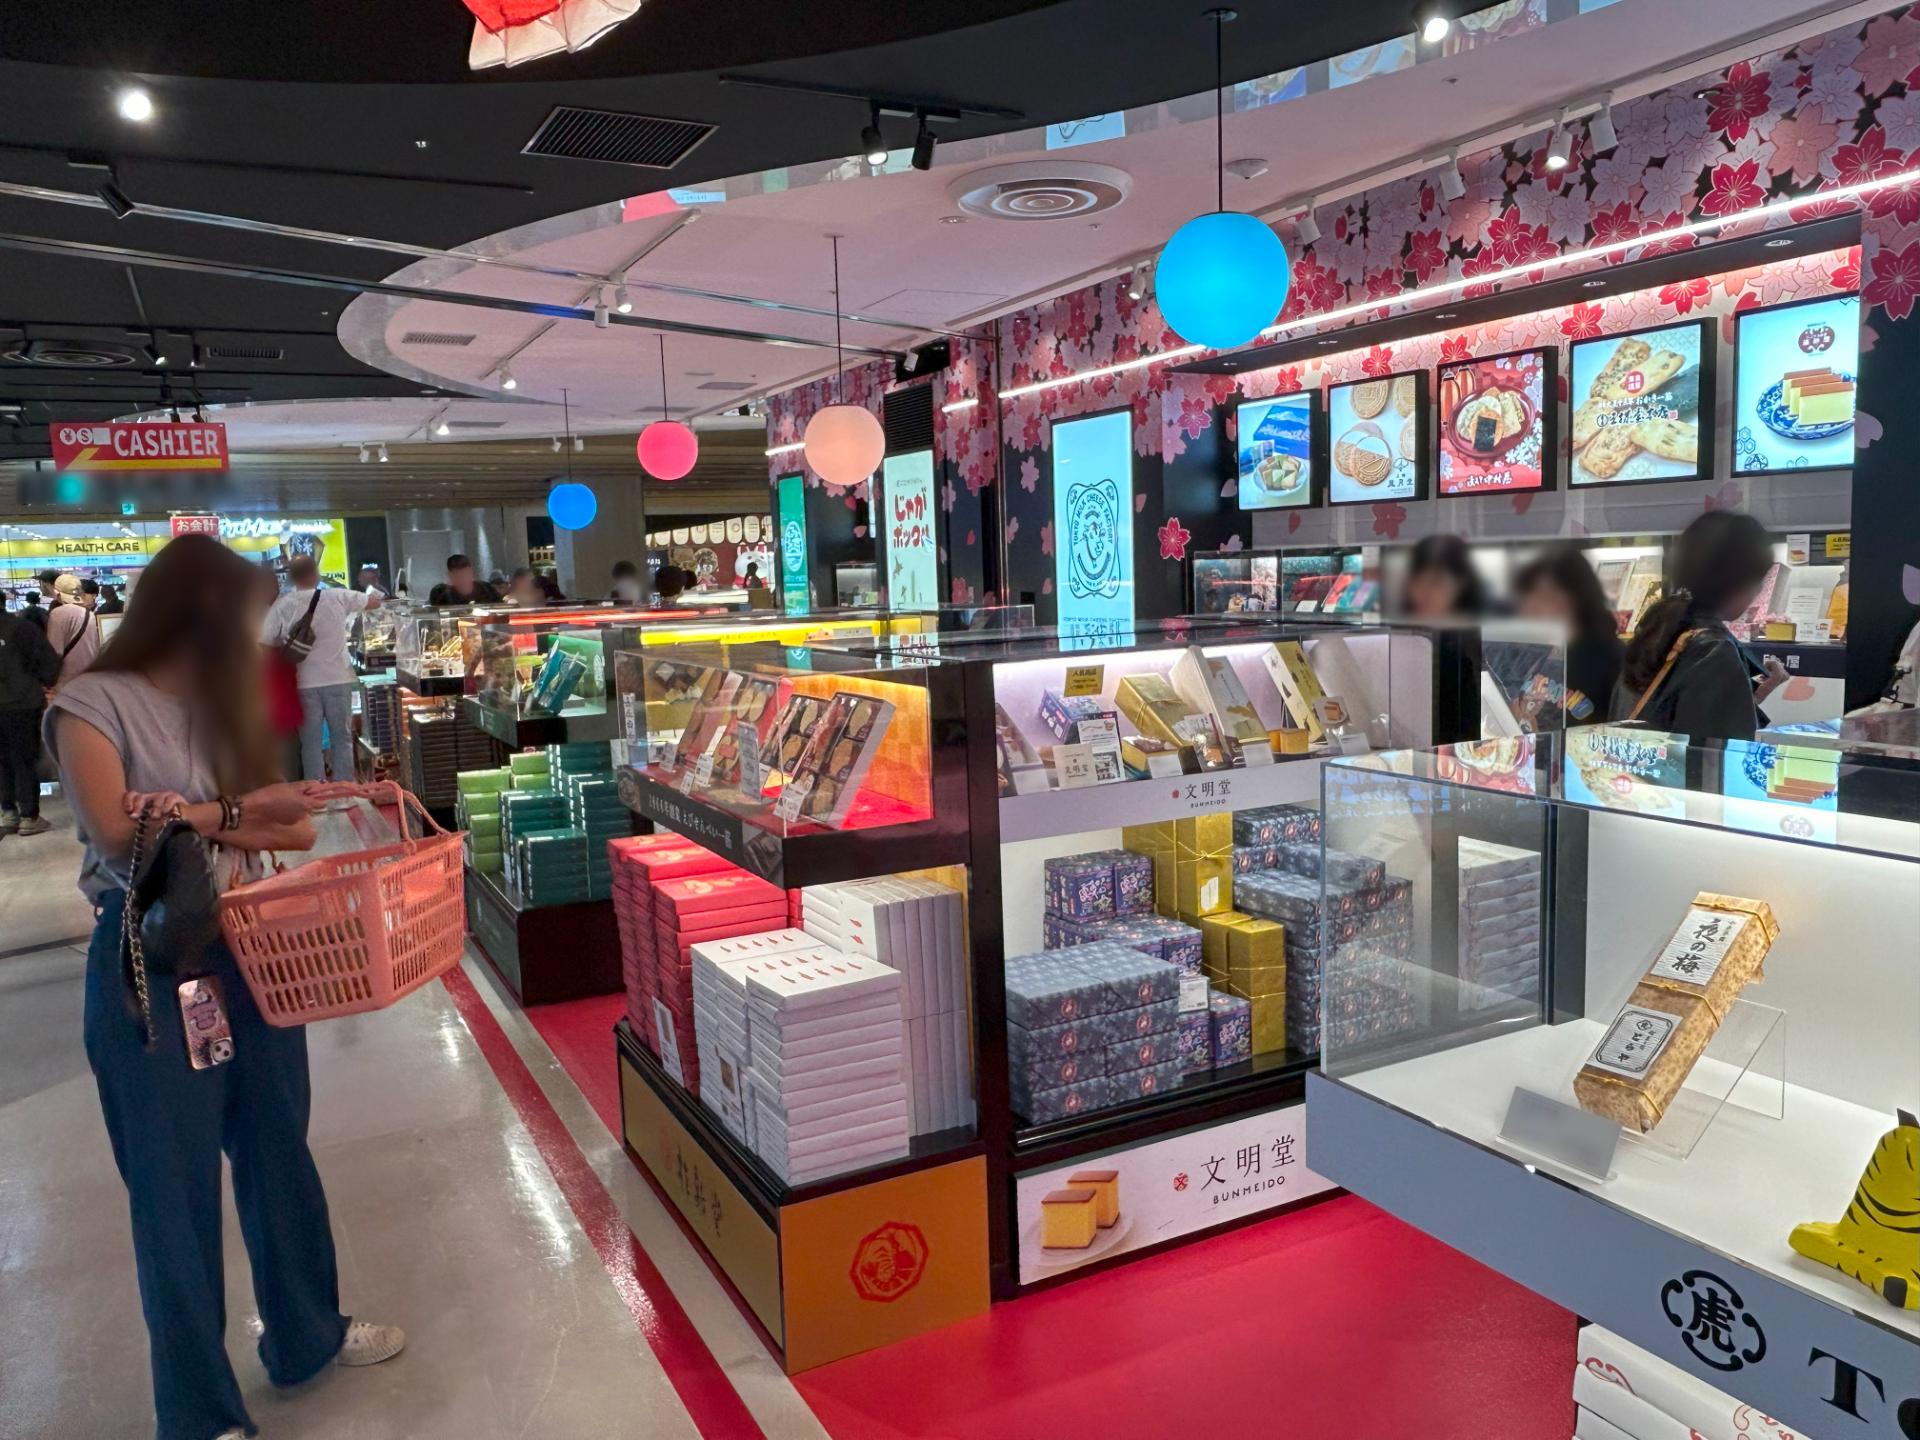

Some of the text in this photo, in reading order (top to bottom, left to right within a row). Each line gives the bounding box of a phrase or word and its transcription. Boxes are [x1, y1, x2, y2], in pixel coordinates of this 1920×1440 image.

[114, 429, 220, 457] CASHIER
[894, 486, 927, 522] じゃが
[176, 519, 218, 532] お会計
[56, 542, 140, 553] HEALTH CARE
[1185, 779, 1231, 799] 文明堂
[1190, 799, 1226, 808] BUNMEIDO
[1671, 918, 1721, 974] 夜の梅
[1617, 1032, 1643, 1062] とらや
[1200, 1134, 1295, 1191] 文明堂
[1213, 1176, 1285, 1205] BUNMEIDO
[1687, 1287, 1736, 1354] 虎
